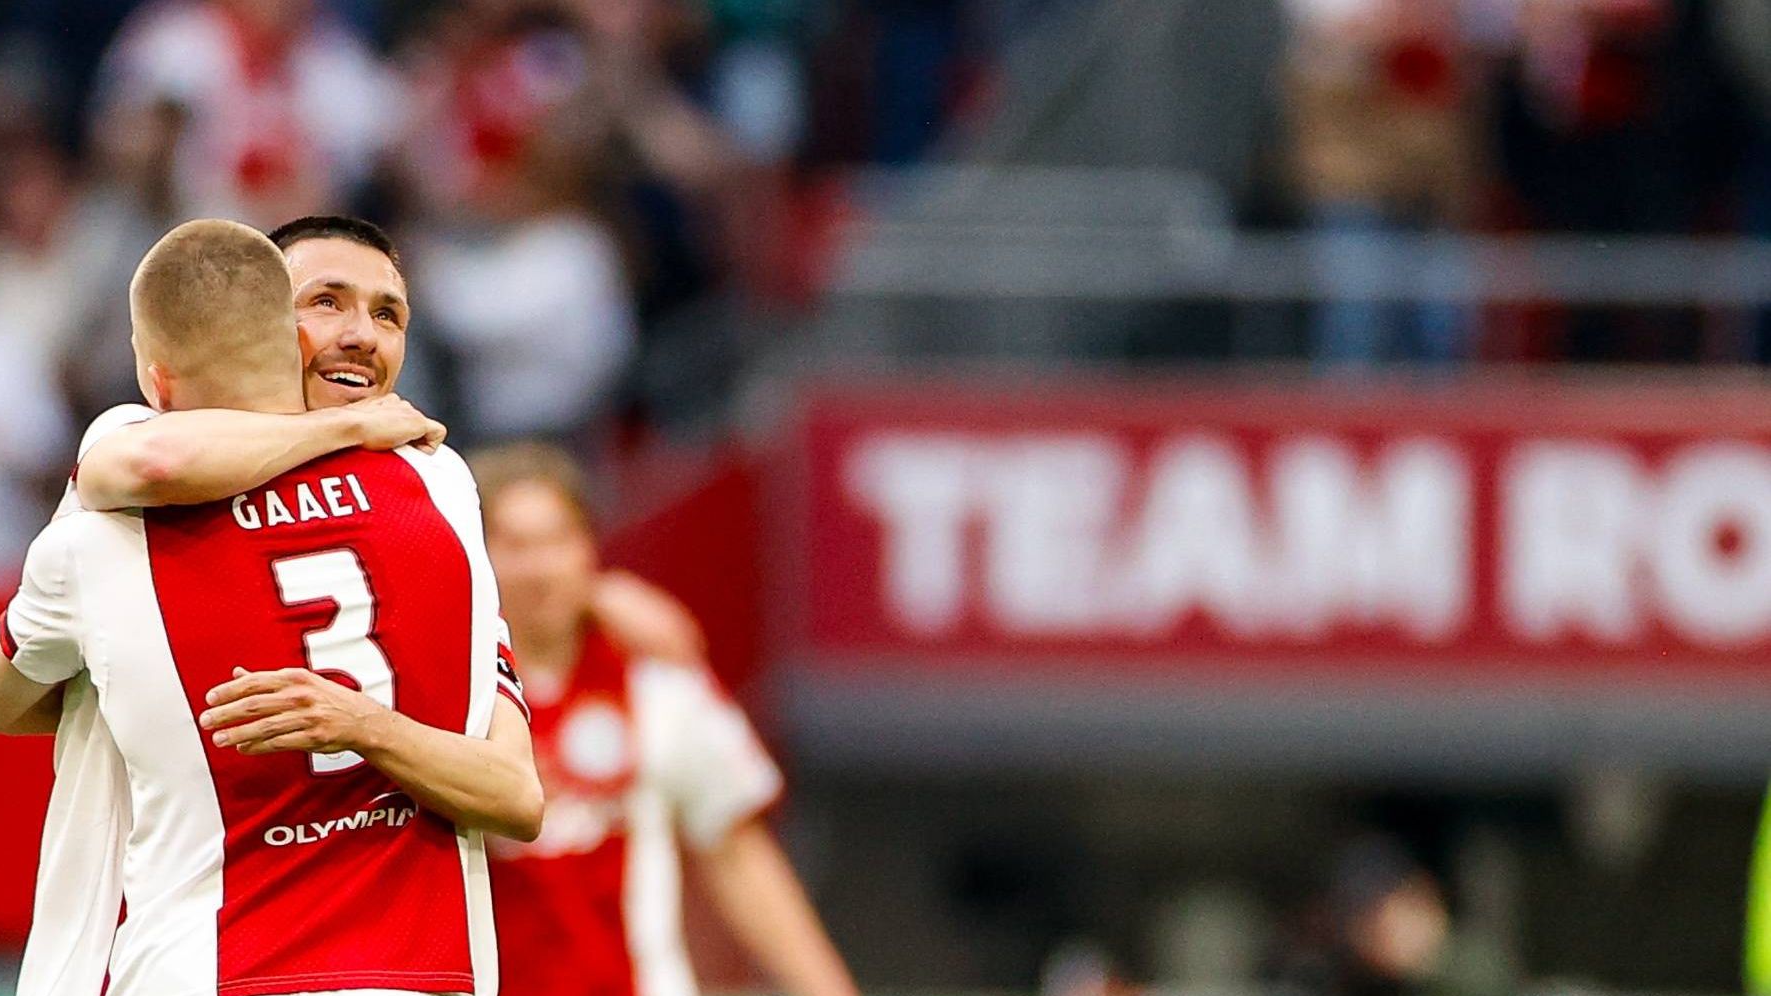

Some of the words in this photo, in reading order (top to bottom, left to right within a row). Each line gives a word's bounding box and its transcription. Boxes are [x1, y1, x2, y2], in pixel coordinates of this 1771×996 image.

[232, 474, 372, 530] GAAEI
[845, 433, 1469, 641] TEAM
[272, 547, 397, 776] 3
